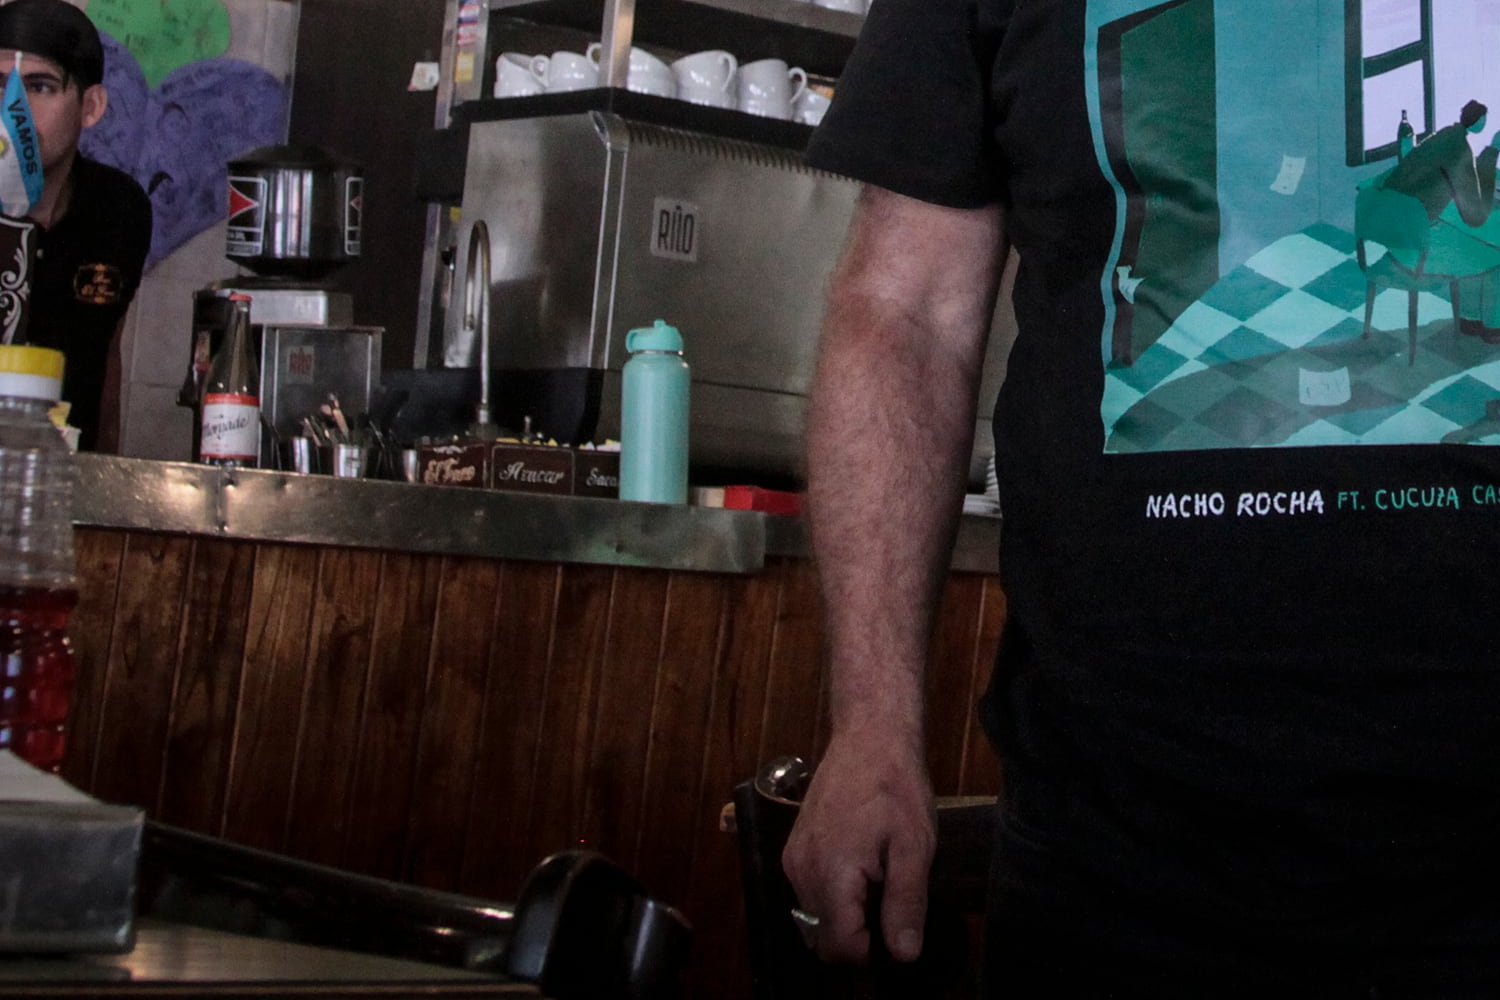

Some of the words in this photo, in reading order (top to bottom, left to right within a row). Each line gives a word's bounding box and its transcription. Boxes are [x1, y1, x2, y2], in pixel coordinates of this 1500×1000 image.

[7, 99, 38, 176] VAMOS
[1145, 492, 1226, 519] NACHO
[1236, 490, 1325, 518] ROCHA
[1337, 491, 1367, 511] FT.
